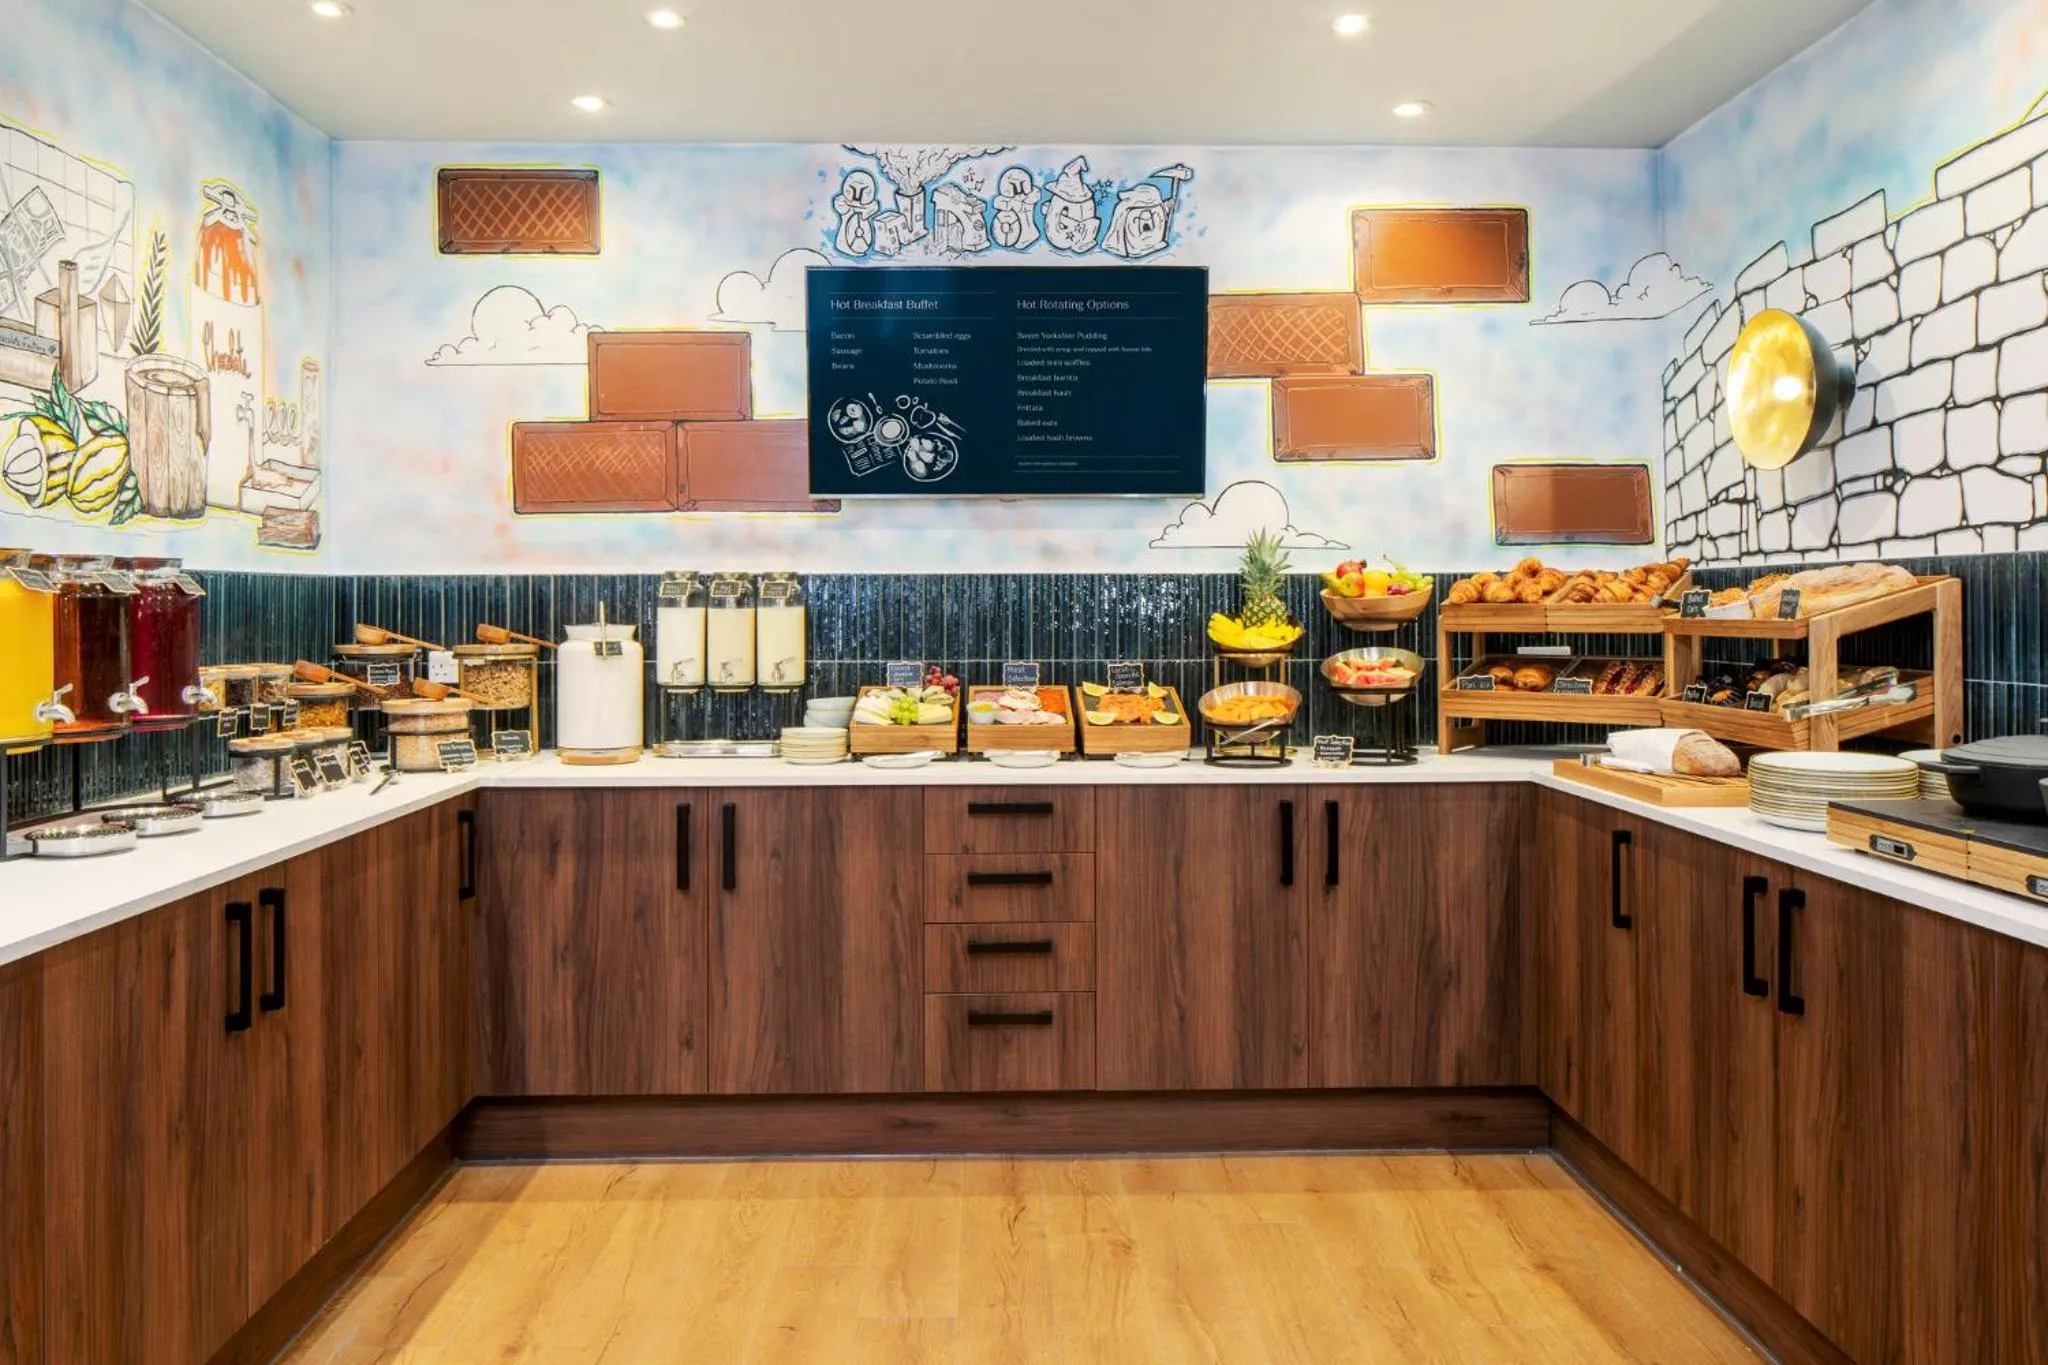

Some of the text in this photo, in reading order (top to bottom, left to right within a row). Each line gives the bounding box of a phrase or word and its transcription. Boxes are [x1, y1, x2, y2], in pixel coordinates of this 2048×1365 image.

[830, 299, 939, 310] Hot Breakfast Buffet
[1016, 299, 1130, 312] Hot Rotating Options
[830, 331, 855, 340] Bacon
[912, 331, 953, 340] Scrambled
[1016, 331, 1109, 341] Sweet Yorkshire Pudding
[1016, 358, 1045, 367] Loaded
[1064, 358, 1091, 367] waffles
[1016, 374, 1051, 382] Breakfast
[1016, 389, 1072, 397] Breakfast hash
[1016, 419, 1058, 427] Baked oats
[1016, 434, 1093, 442] Loaded hash browns
